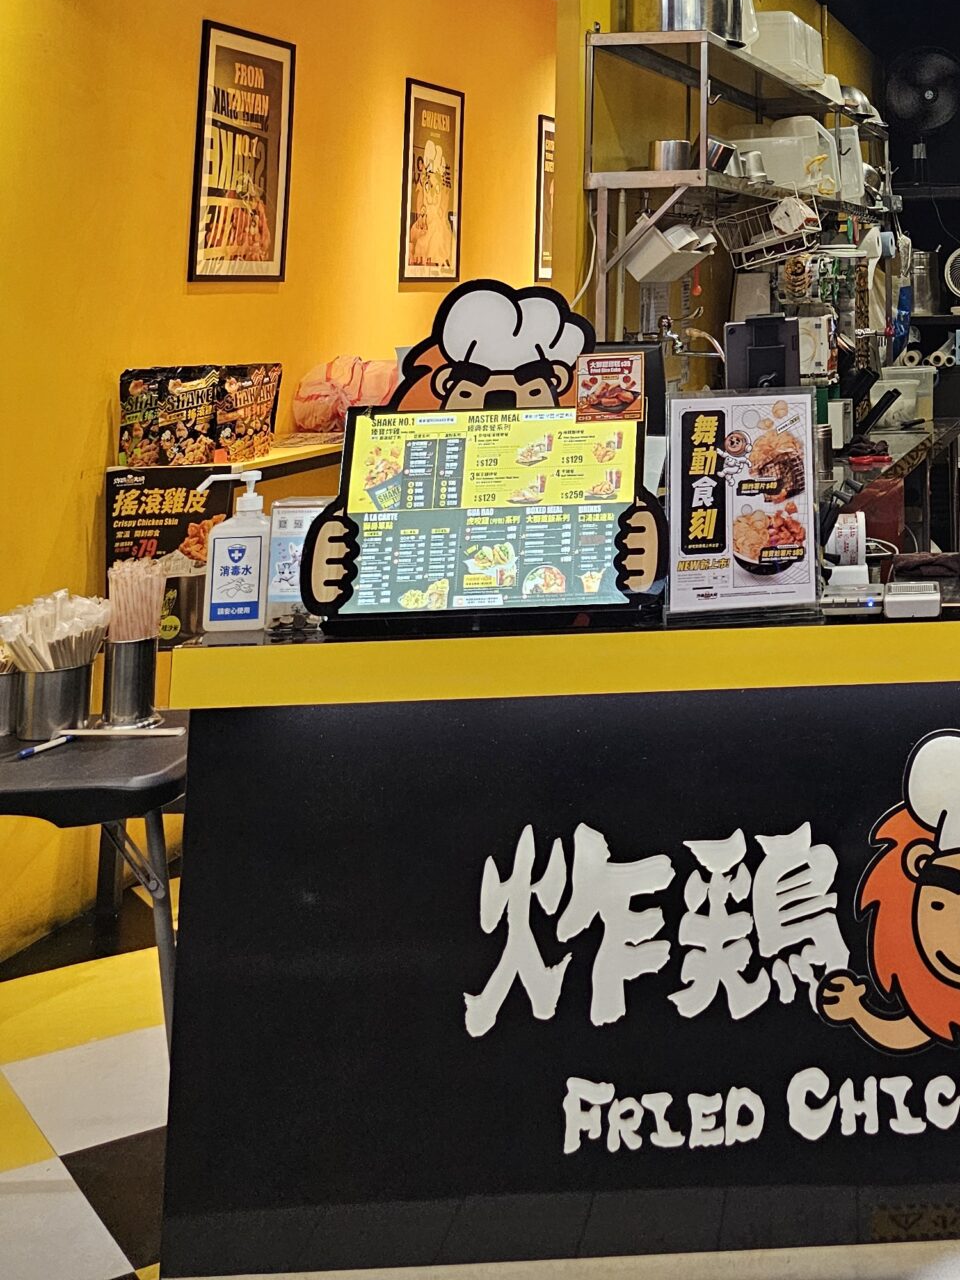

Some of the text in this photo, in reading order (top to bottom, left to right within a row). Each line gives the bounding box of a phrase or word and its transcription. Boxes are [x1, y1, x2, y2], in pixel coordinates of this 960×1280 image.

[234, 62, 265, 89] FROM
[228, 87, 269, 116] TAIWAN
[421, 109, 450, 133] CHICKEN
[372, 418, 397, 427] SHAKE
[399, 417, 415, 426] NO.1
[468, 414, 499, 424] MASTER
[500, 414, 520, 423] MEAL
[480, 458, 498, 467] $129
[565, 455, 584, 464] $129
[688, 415, 718, 540] 舞動食刻
[112, 488, 209, 517] 搖滾雞皮
[478, 493, 496, 502] $129
[113, 518, 179, 528] Crispy Chicken Skin
[116, 530, 160, 539] 常溫 開封即食
[131, 539, 158, 558] $79
[220, 564, 253, 577] 消毒水
[217, 607, 250, 616] 請安心使用
[563, 1077, 765, 1154] FRIED
